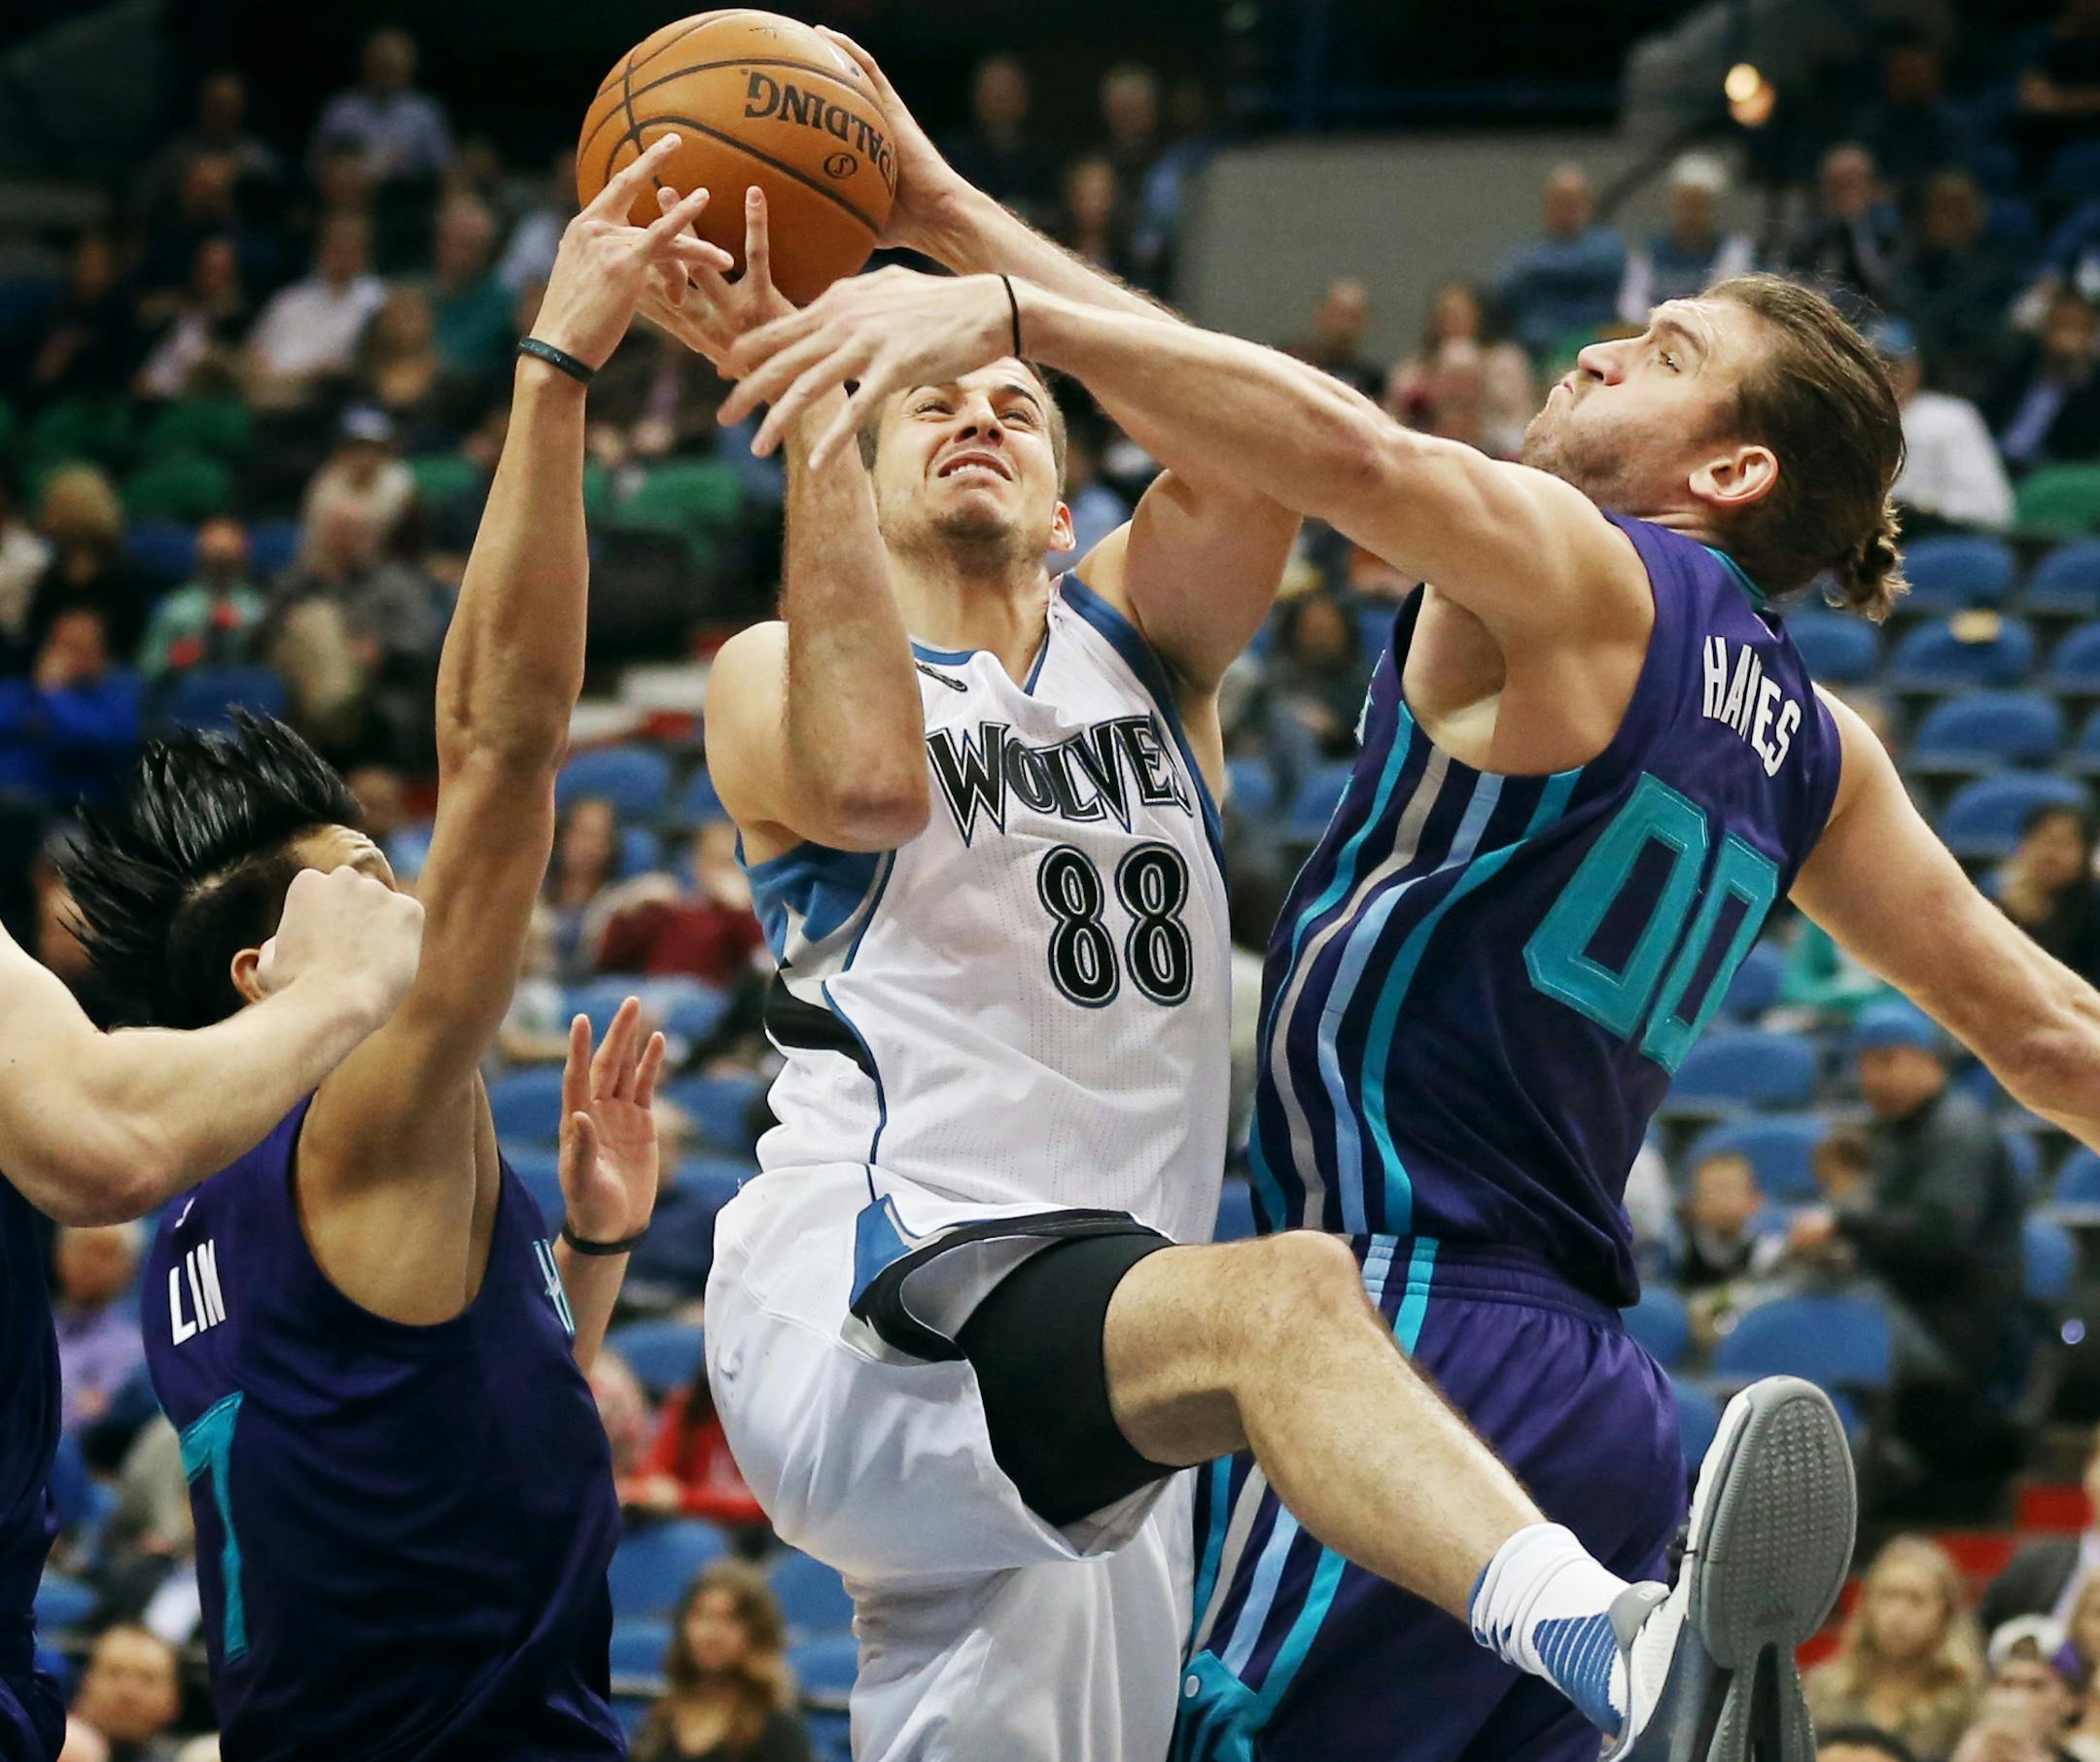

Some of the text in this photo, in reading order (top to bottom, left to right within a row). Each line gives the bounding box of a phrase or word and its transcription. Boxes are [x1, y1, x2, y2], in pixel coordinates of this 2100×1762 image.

[745, 71, 895, 197] PALDING
[1036, 841, 1194, 1008] 88
[1522, 771, 1779, 1074] 00
[168, 1238, 227, 1347] LIN
